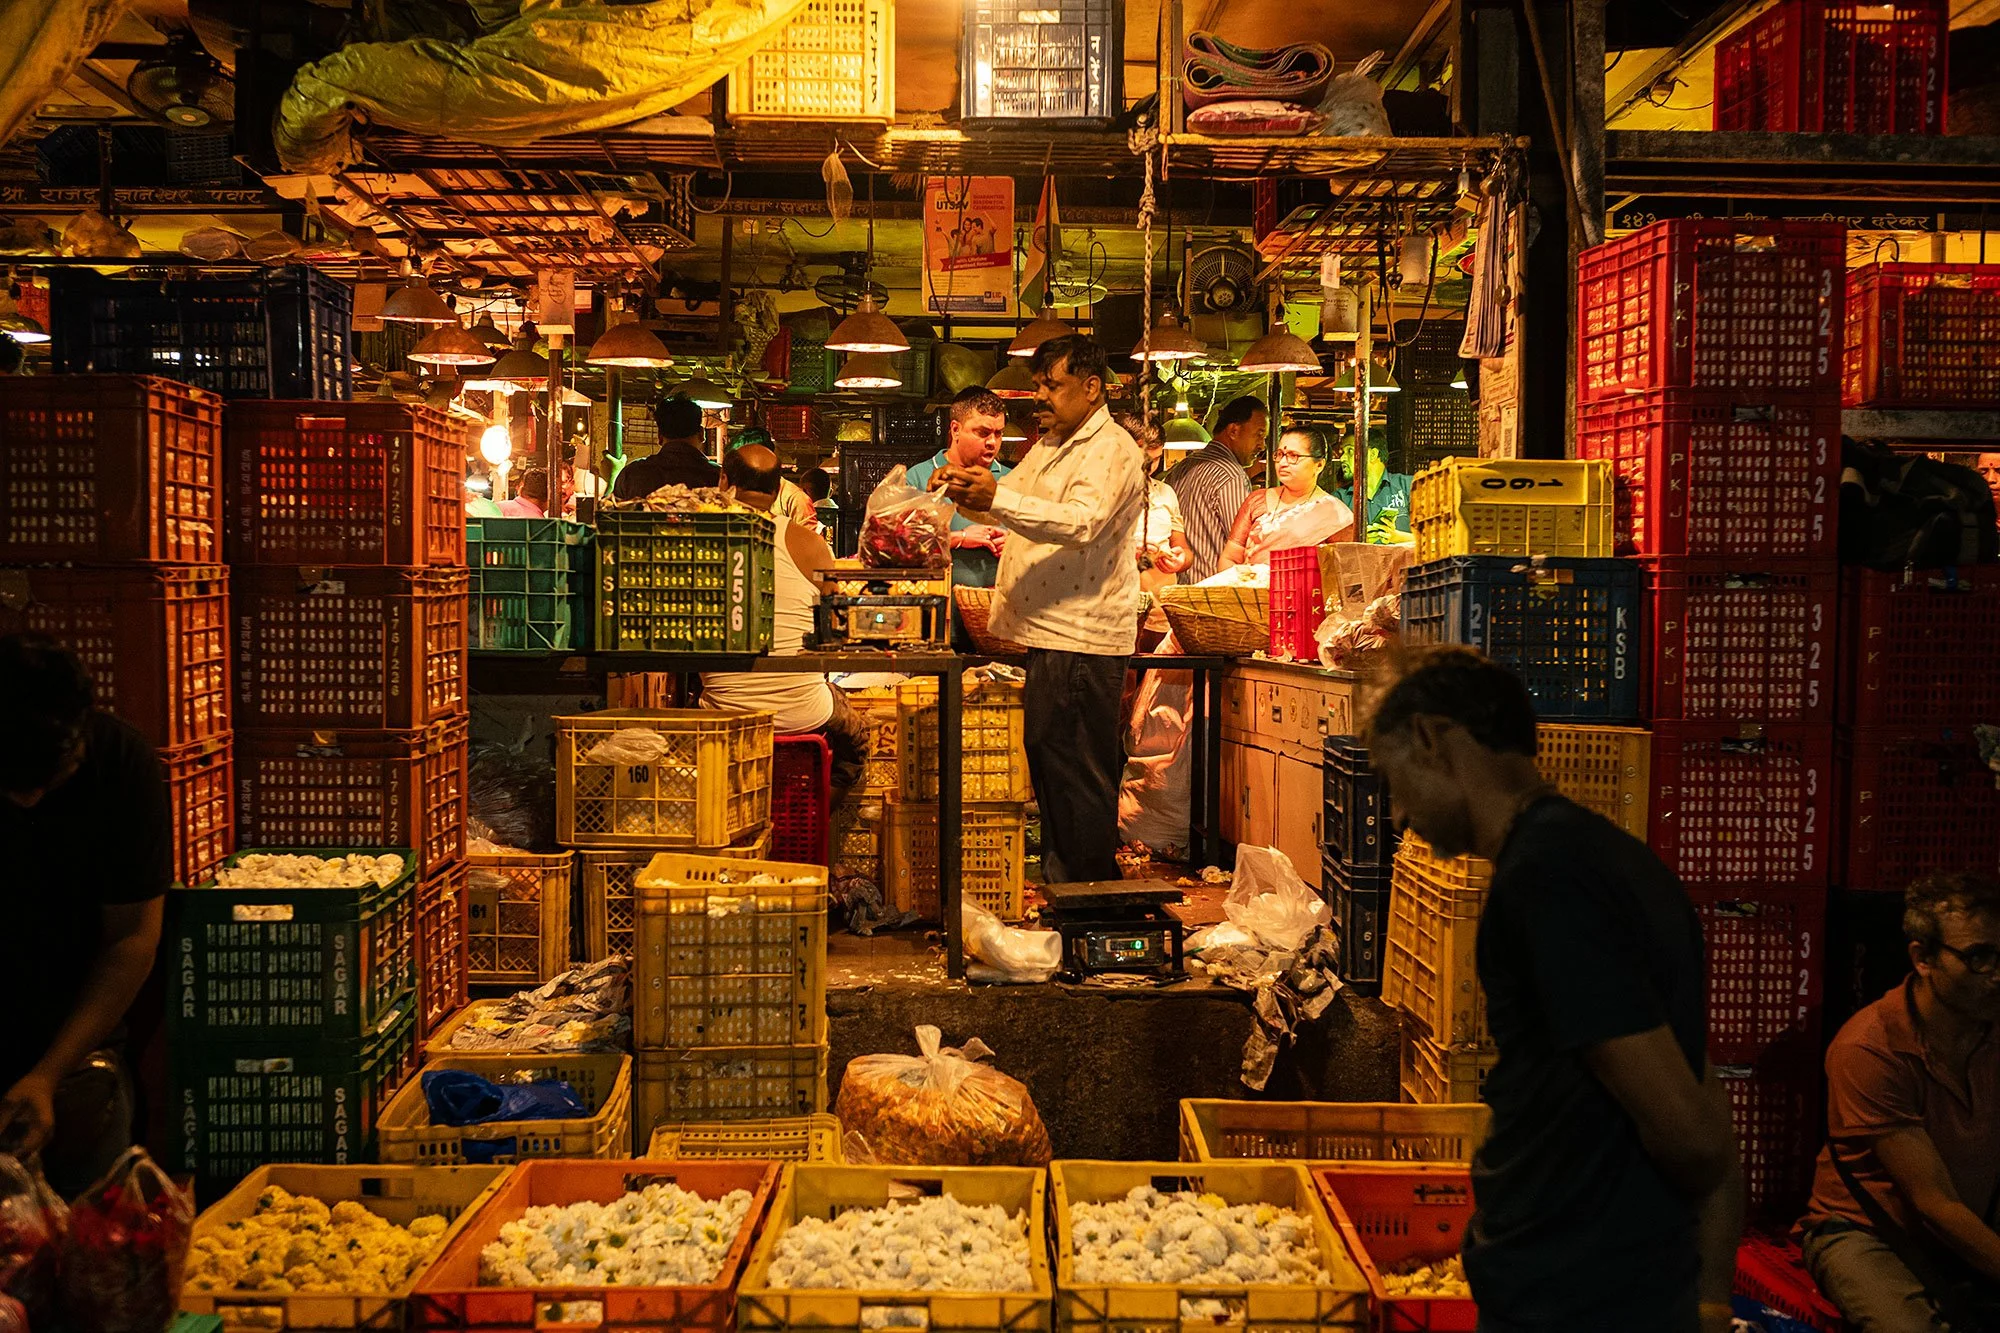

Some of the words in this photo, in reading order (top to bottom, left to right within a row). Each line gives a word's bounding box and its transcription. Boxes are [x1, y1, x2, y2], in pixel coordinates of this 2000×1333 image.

[936, 200, 968, 210] UTSAV
[1675, 282, 1691, 348] PKJ
[1817, 269, 1832, 375] 325
[1481, 478, 1564, 490] 160
[1669, 453, 1685, 518] PKJ
[1812, 437, 1827, 541] 325
[602, 550, 615, 617] KSB
[731, 551, 745, 632] 256
[1614, 607, 1629, 680] KSB
[1663, 620, 1679, 686] PKJ
[1808, 603, 1823, 707] 325
[1866, 626, 1882, 691] PKJ
[628, 765, 649, 783] 160
[1366, 794, 1377, 846] 160
[1803, 769, 1818, 871] 325
[181, 937, 196, 1019] SAGAR
[333, 934, 348, 1016] SAGAR
[1797, 931, 1812, 1033] 325
[334, 1087, 349, 1165] SAGAR
